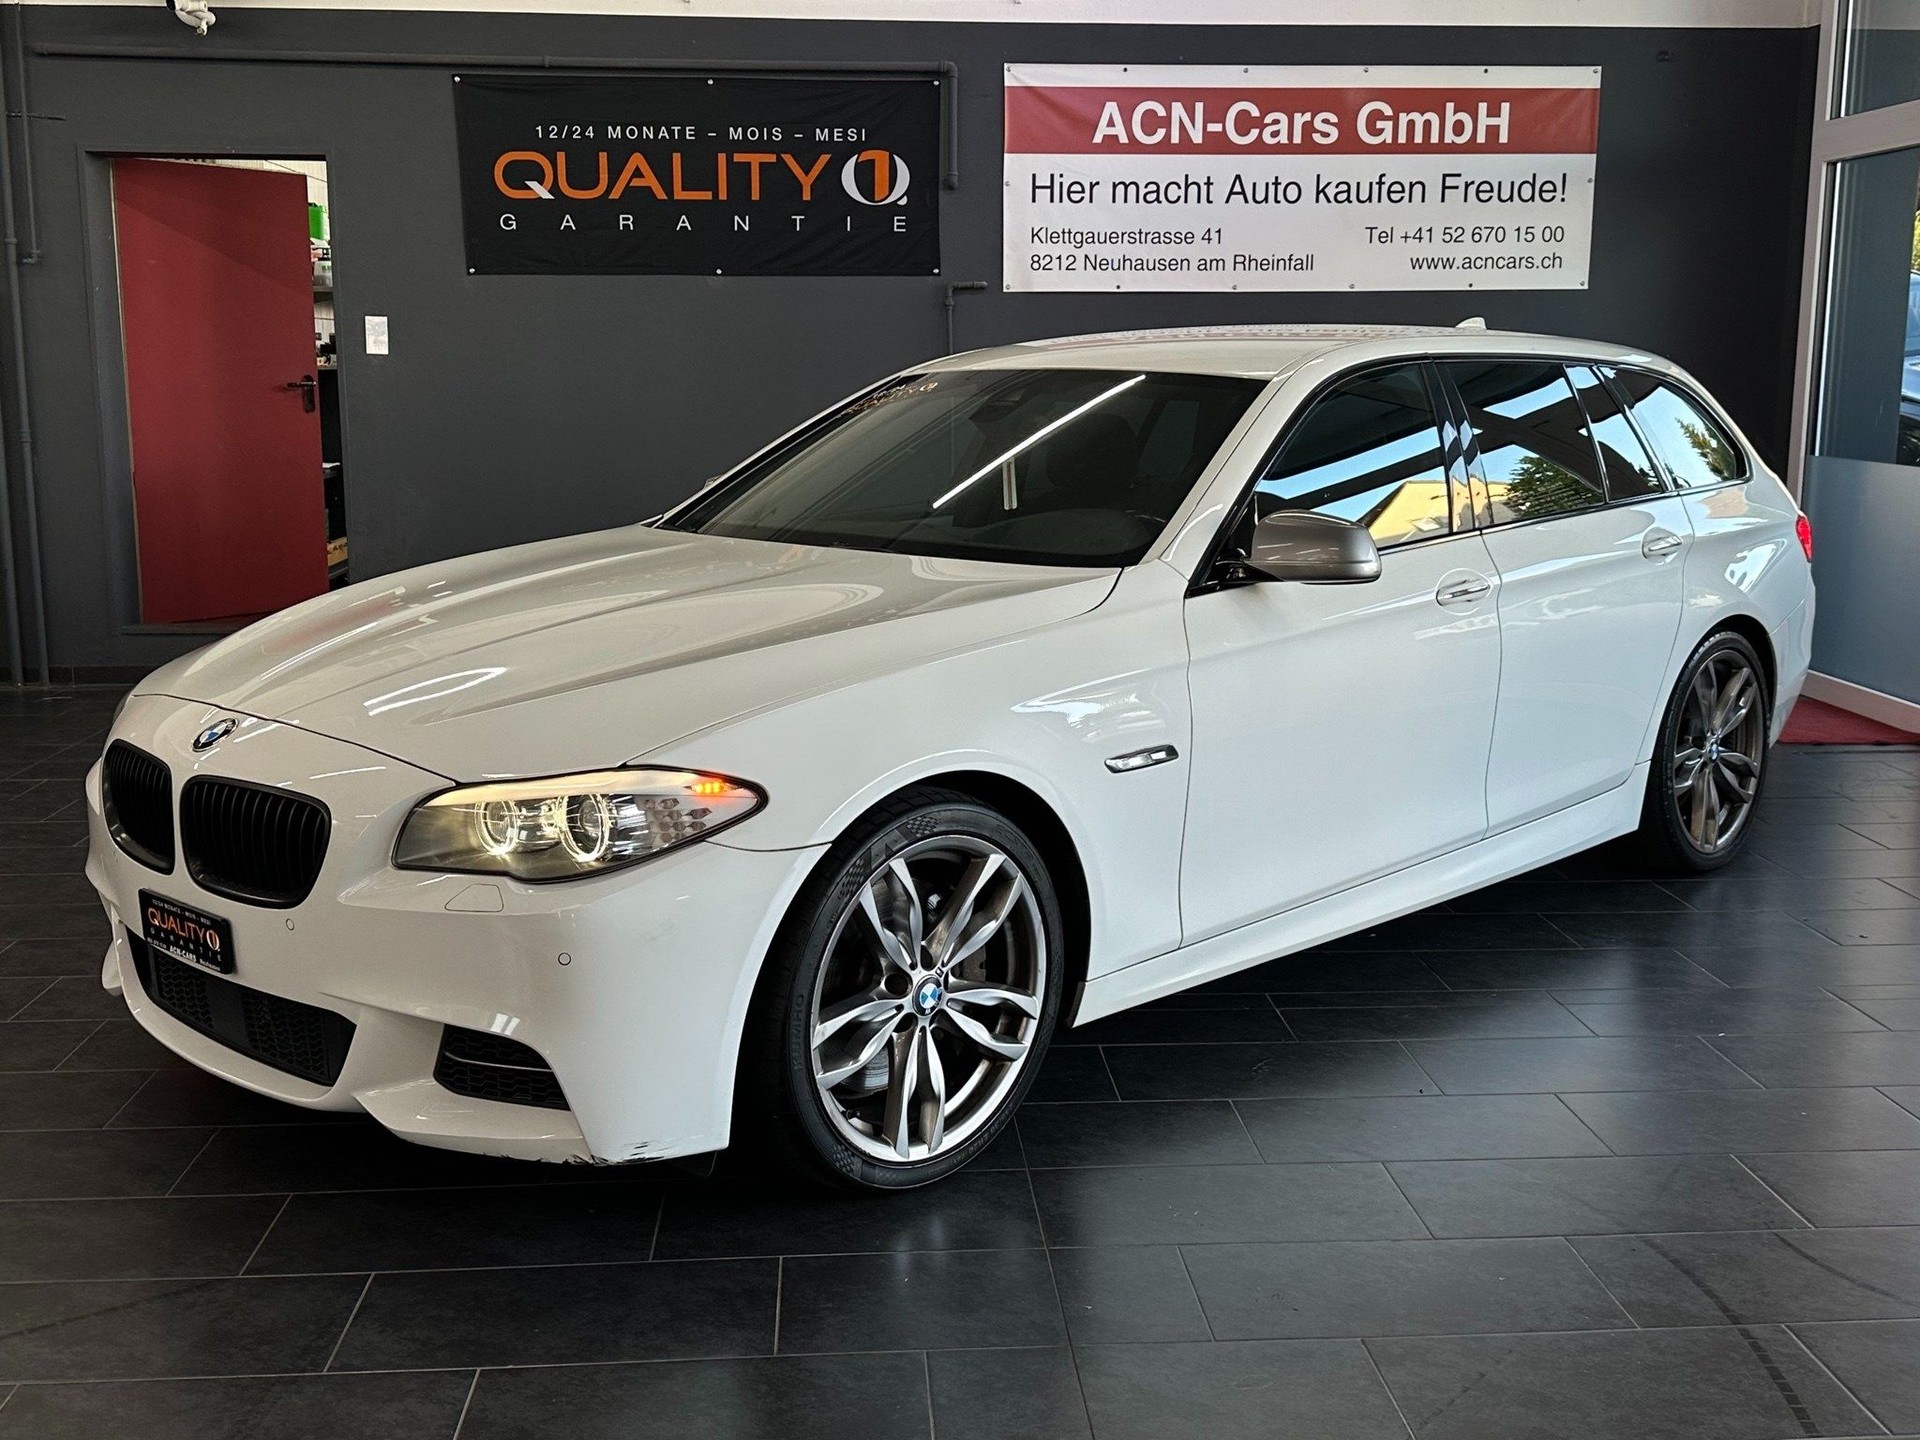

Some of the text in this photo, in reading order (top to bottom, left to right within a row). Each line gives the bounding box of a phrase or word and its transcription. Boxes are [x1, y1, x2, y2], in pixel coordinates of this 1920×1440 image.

[1092, 100, 1510, 145] ACN-Cars GmbH
[535, 125, 595, 139] 12/24
[607, 125, 696, 140] MONATE
[729, 126, 783, 141] MOIS
[815, 128, 866, 142] MESI
[493, 150, 832, 201] QUALITY
[1031, 172, 1567, 205] Hier macht Auto kaufen Freude!
[499, 213, 907, 232] GARANTIE
[1031, 226, 1222, 249] Klettgauerstrasse 41
[1364, 225, 1565, 244] Tel +41 52 670 15 00
[1030, 253, 1314, 272] 8212 Neuhausen am Rheinfall
[1410, 252, 1563, 270] www.acncars.ch
[148, 907, 205, 944] QUALITY
